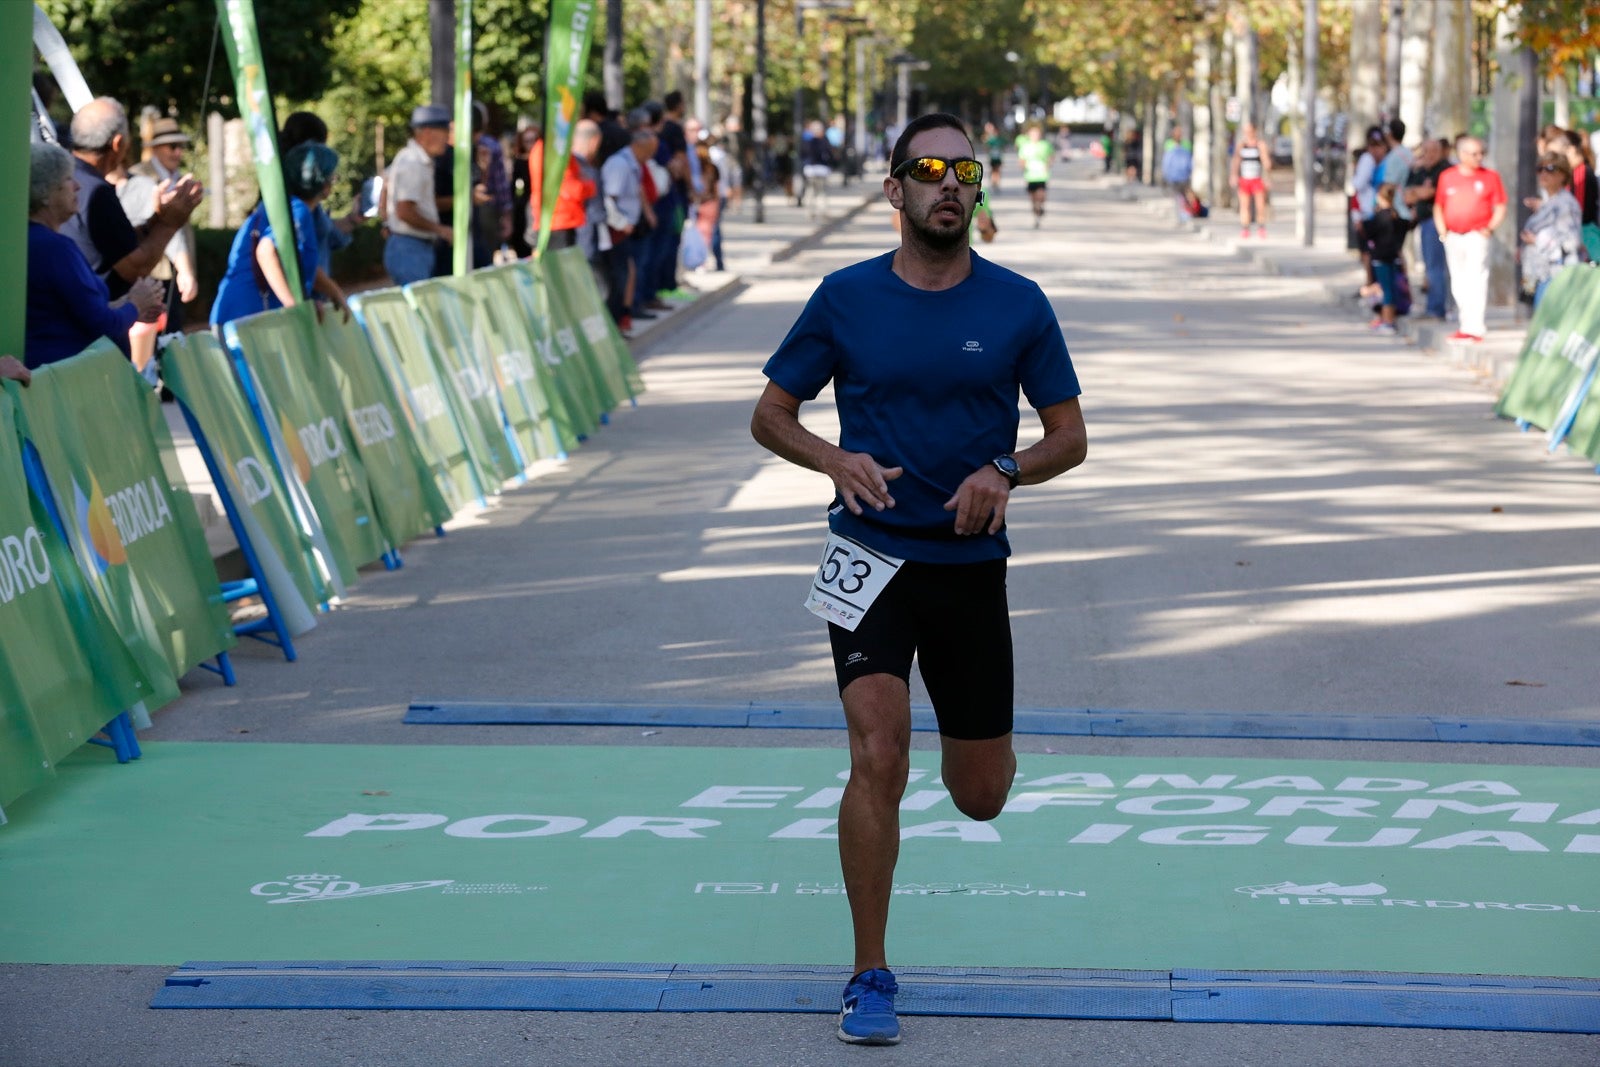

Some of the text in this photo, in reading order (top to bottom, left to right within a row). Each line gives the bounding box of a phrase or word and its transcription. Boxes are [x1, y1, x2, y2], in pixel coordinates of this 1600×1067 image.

[819, 544, 872, 594] 53
[1001, 791, 1600, 825] FORM
[304, 812, 721, 840] POR
[250, 881, 361, 898] CSD
[964, 889, 1086, 897] JOVEN
[1279, 897, 1600, 913] IBERDROL
